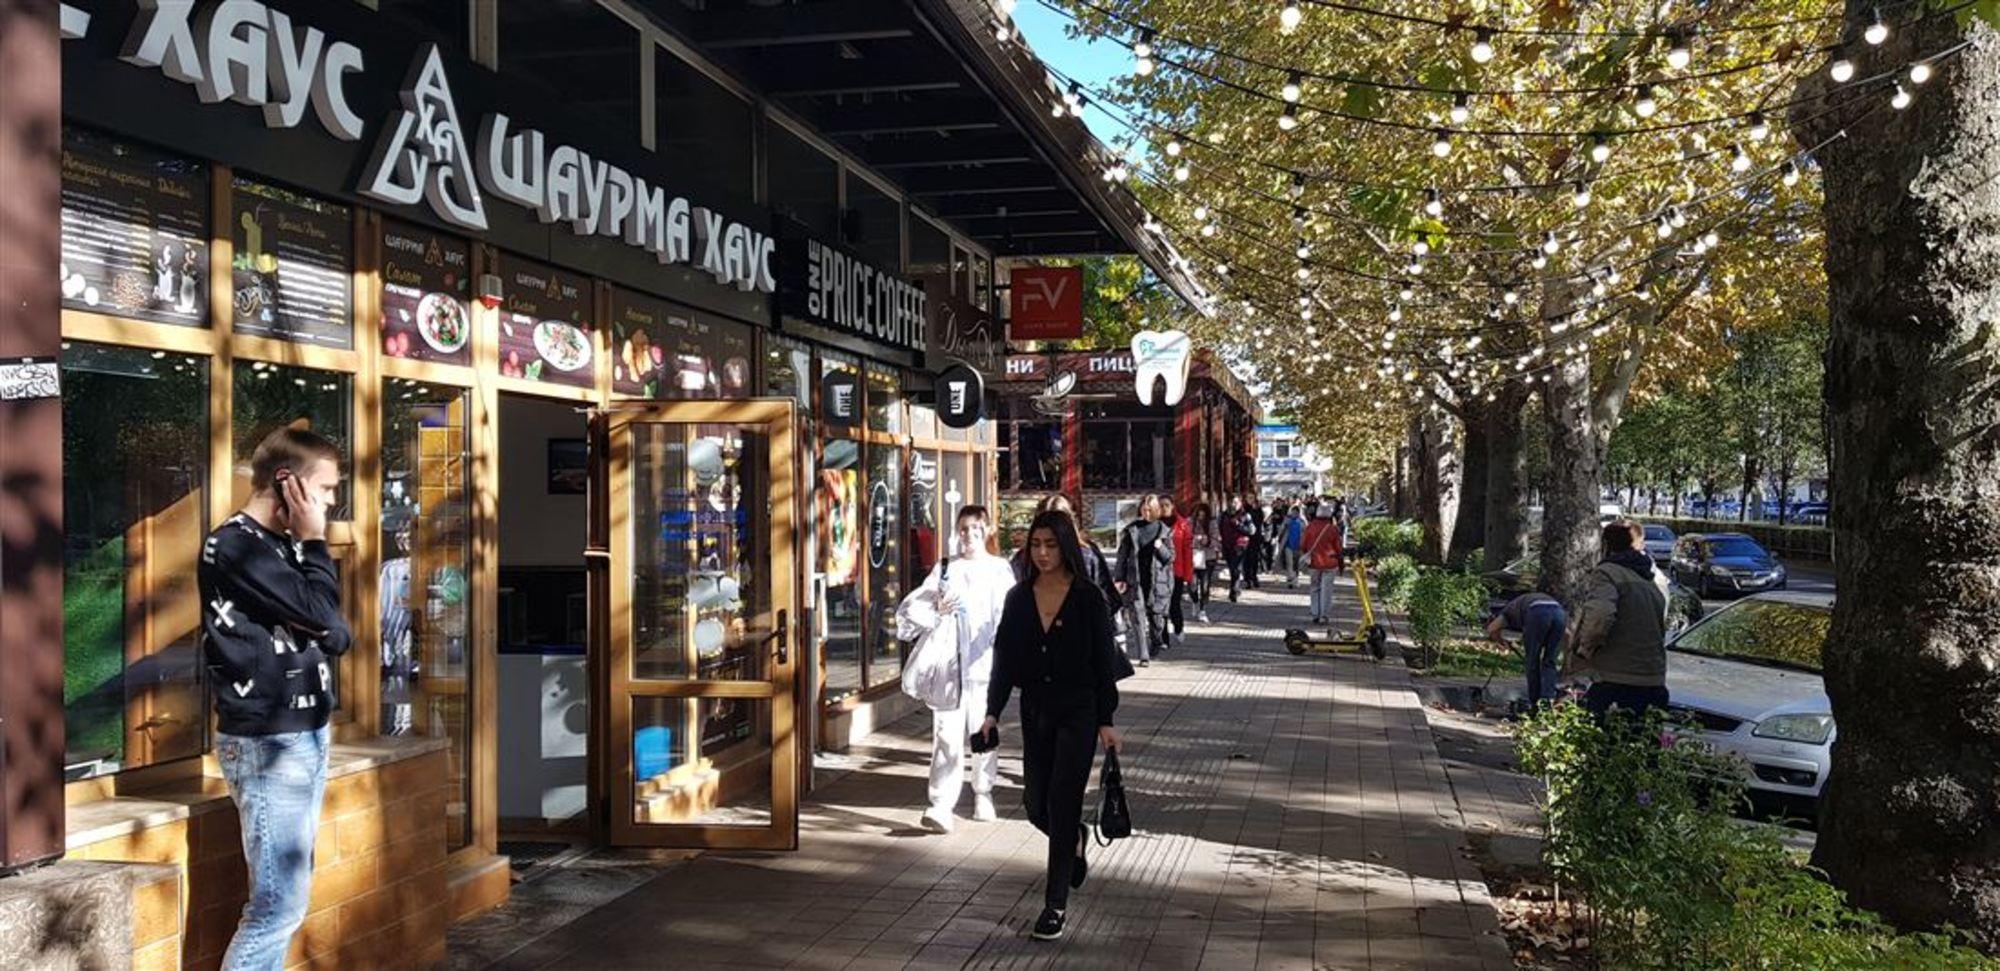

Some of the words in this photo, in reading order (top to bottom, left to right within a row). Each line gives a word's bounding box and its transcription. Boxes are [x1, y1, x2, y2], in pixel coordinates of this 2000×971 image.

[122, 0, 364, 140] ХАУС
[485, 113, 690, 263] ШАУРМА
[697, 207, 776, 292] ХАУС
[808, 238, 821, 316] ONE
[821, 245, 874, 335] PRICE
[875, 271, 927, 352] COFFEE
[1089, 357, 1138, 373] ПИЦ
